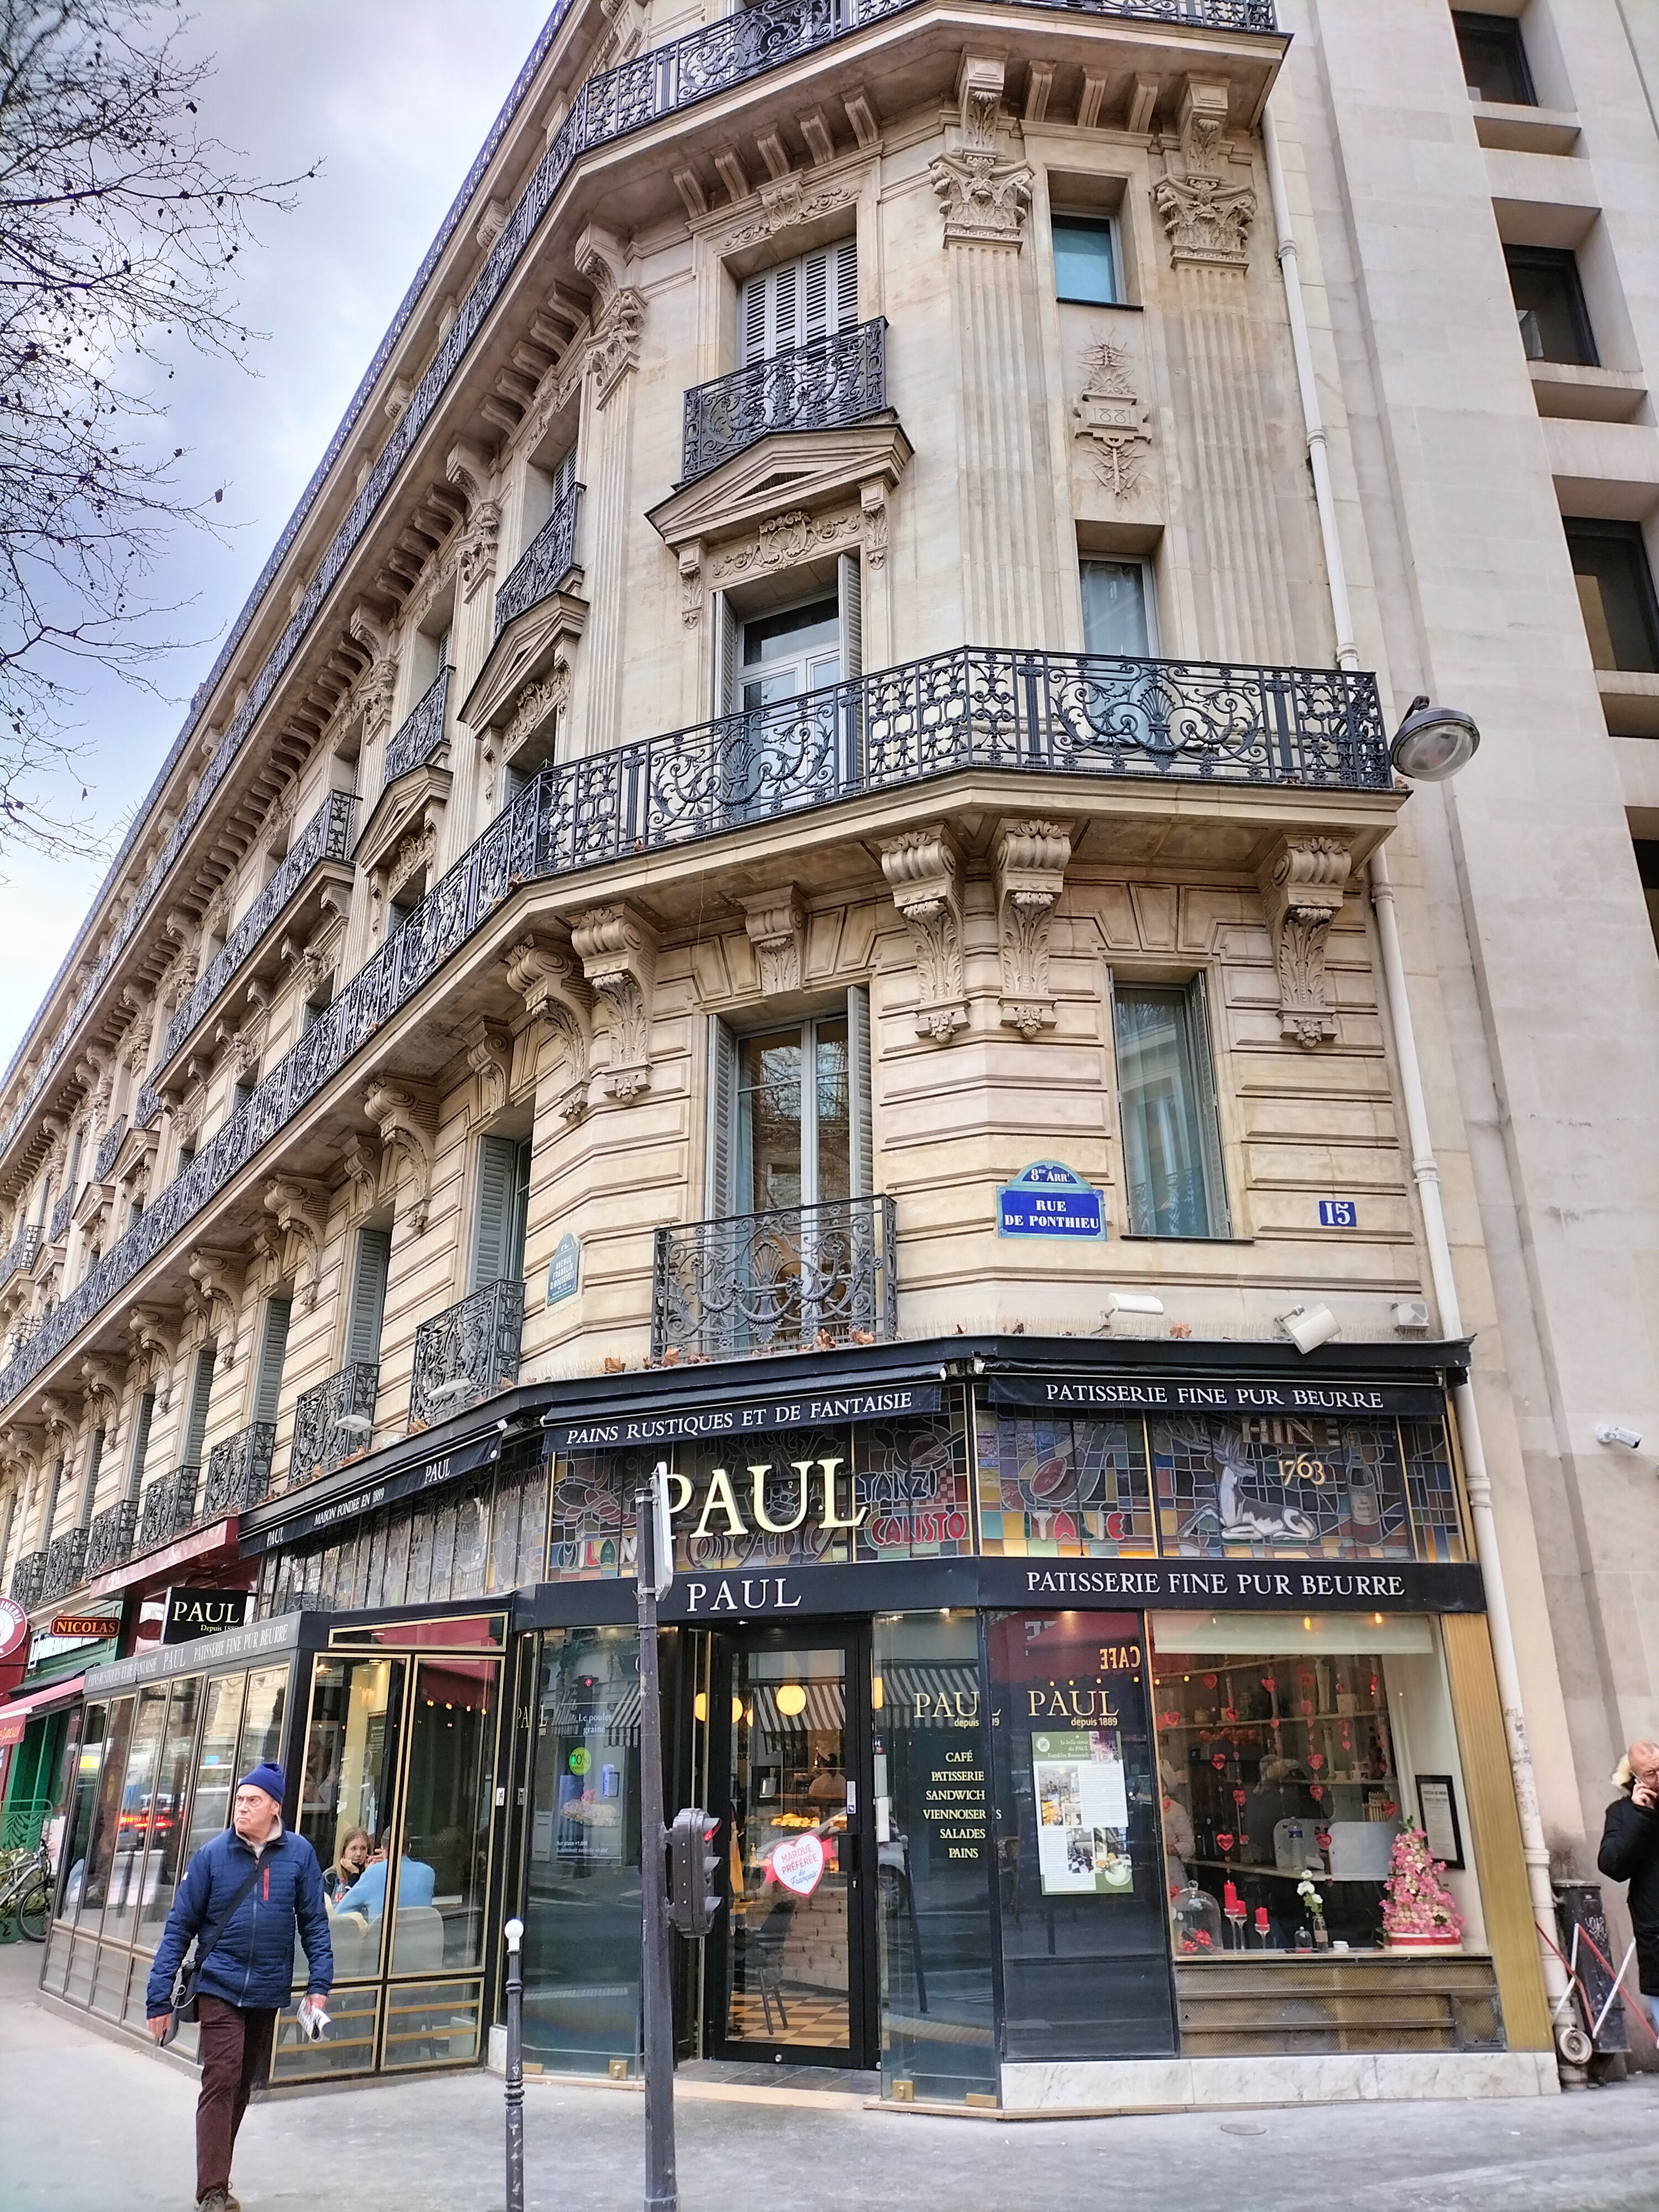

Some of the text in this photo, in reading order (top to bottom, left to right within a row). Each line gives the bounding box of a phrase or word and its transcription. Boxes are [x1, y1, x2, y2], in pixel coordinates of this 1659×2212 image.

[1036, 1200, 1066, 1212] RUE
[1325, 1202, 1350, 1224] 15
[1004, 1214, 1099, 1228] DE PONTHIEU
[553, 1263, 573, 1280] FRANKLIN
[556, 1255, 572, 1270] AVENUE
[554, 1270, 575, 1288] ROOSEVELT
[1045, 1384, 1383, 1408] PATISSERIE FINE PUR BEURRE
[566, 1392, 912, 1444] PAINS RUSTIQUES ET DE FANTAISIE
[424, 1458, 450, 1484] PAUL
[1279, 1453, 1325, 1486] 1763
[314, 1488, 384, 1526] MAISON FONDEE EN 1889
[872, 1512, 966, 1545] CALISTO
[1024, 1511, 1125, 1540] ITALIE
[267, 1527, 284, 1547] PAUL
[1026, 1572, 1405, 1596] PATISSERIE FINE PUR BEURRE
[686, 1578, 802, 1612] PAUL
[172, 1601, 240, 1623] PAUL
[56, 1621, 116, 1633] NICOLAS
[200, 1624, 222, 1633] Depuis
[194, 1624, 288, 1662] PATISSERIE FINE PUR BEURRE
[163, 1648, 186, 1671] PAUL
[914, 1692, 1001, 1718] PAU
[1027, 1691, 1119, 1716] PAUL
[517, 1705, 547, 1729] PAL
[579, 1712, 612, 1723] Le poulet
[954, 1718, 979, 1729] depuis
[1071, 1717, 1118, 1728] depuis 1889
[583, 1726, 606, 1735] grainé
[946, 1750, 973, 1762] CAFÉ
[931, 1771, 984, 1781] PATISSERIE
[926, 1790, 985, 1800] SANDWICH
[923, 1809, 1002, 1819] VIENNOISERS
[940, 1828, 985, 1839] SALADES
[781, 1844, 813, 1864] MARQUE
[949, 1848, 978, 1858] PAINS
[781, 1854, 818, 1875] PRÉFÉRÉE
[790, 1870, 818, 1887] Français
